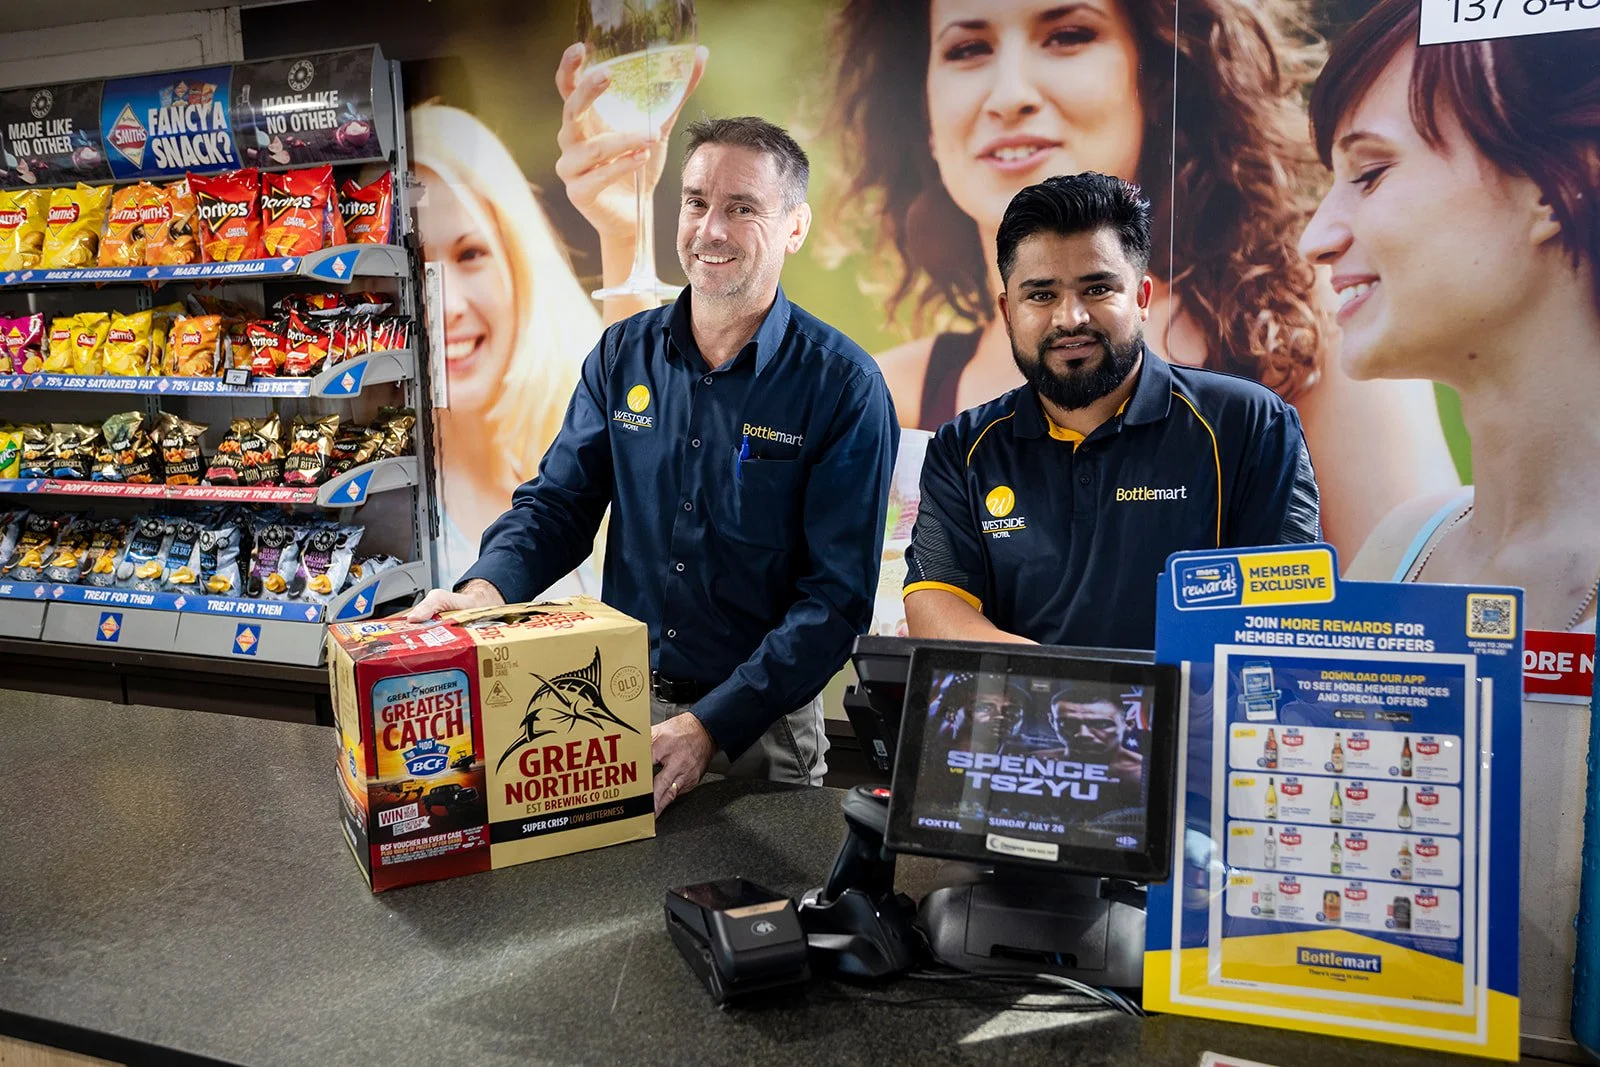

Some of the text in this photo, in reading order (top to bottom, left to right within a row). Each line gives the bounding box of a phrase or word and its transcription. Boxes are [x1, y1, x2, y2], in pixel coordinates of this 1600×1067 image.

[1447, 0, 1502, 23] 137
[262, 90, 339, 116] MADE LIKE
[148, 101, 227, 136] FANCY A
[266, 110, 338, 134] NO OTHER
[8, 118, 73, 140] MADE LIKE
[12, 136, 73, 157] NO OTHER
[151, 131, 234, 169] SNACK?
[339, 201, 376, 216] oritos
[45, 269, 131, 279] MADE IN AUSTRALIA
[173, 262, 265, 276] MADE IN AUSTRALIA
[45, 377, 63, 387] 75%
[64, 378, 86, 388] LESS
[86, 379, 138, 389] SATURATED
[172, 381, 190, 391] 75%
[191, 381, 215, 391] LESS
[614, 410, 653, 425] WESTSIDE
[743, 423, 804, 447] Bottlemart
[62, 483, 163, 496] DON'T FORGET THE DIP!
[184, 487, 292, 500] DON'T FORGET THE DIP!
[1116, 485, 1187, 502] Bottlemart
[982, 516, 1025, 531] WESTSIDE
[992, 531, 1011, 539] HOTEL
[1196, 568, 1219, 577] more
[1249, 564, 1310, 578] MEMBER
[1182, 572, 1238, 597] rewards
[1250, 577, 1326, 593] EXCLUSIVE
[83, 590, 155, 605] TREAT FOR THEM
[207, 600, 283, 616] TREAT FOR THEM
[1244, 616, 1425, 636] JOIN MORE REWARDS FOR
[1234, 630, 1435, 652] MEMBER EXCLUSIVE OFFERS
[494, 646, 509, 662] 30
[1522, 650, 1574, 673] ORE
[618, 676, 637, 692] QLD
[1320, 670, 1425, 684] DOWNLOAD OUR APP
[387, 681, 458, 703] GREAT NORTHERN
[1297, 680, 1450, 697] TO SEE MORE MEMBER PRICES
[382, 689, 463, 724] GREATEST
[1317, 692, 1428, 707] AND SPECIAL OFFERS
[383, 708, 464, 752] CATCH
[518, 734, 622, 778] GREAT
[411, 758, 445, 773] BCF
[947, 750, 1109, 782] SPENCE
[505, 761, 638, 805] NORTHERN
[965, 771, 1099, 801] TSZYU
[526, 788, 620, 814] EST BREWING CO QLD
[381, 808, 404, 825] WIN
[522, 805, 625, 833] SUPER CRISP LOW BITTERNESS
[918, 817, 962, 830] FOXTEL
[988, 817, 1026, 829] SUNDAY
[1028, 821, 1050, 833] JULY
[1051, 823, 1065, 834] 26
[380, 843, 393, 851] BCF
[393, 838, 421, 849] VOUCHER
[421, 836, 429, 844] IN
[428, 833, 447, 843] EVERY
[447, 830, 463, 839] CASE
[1301, 950, 1378, 971] Bottlemart
[1309, 968, 1330, 977] There's
